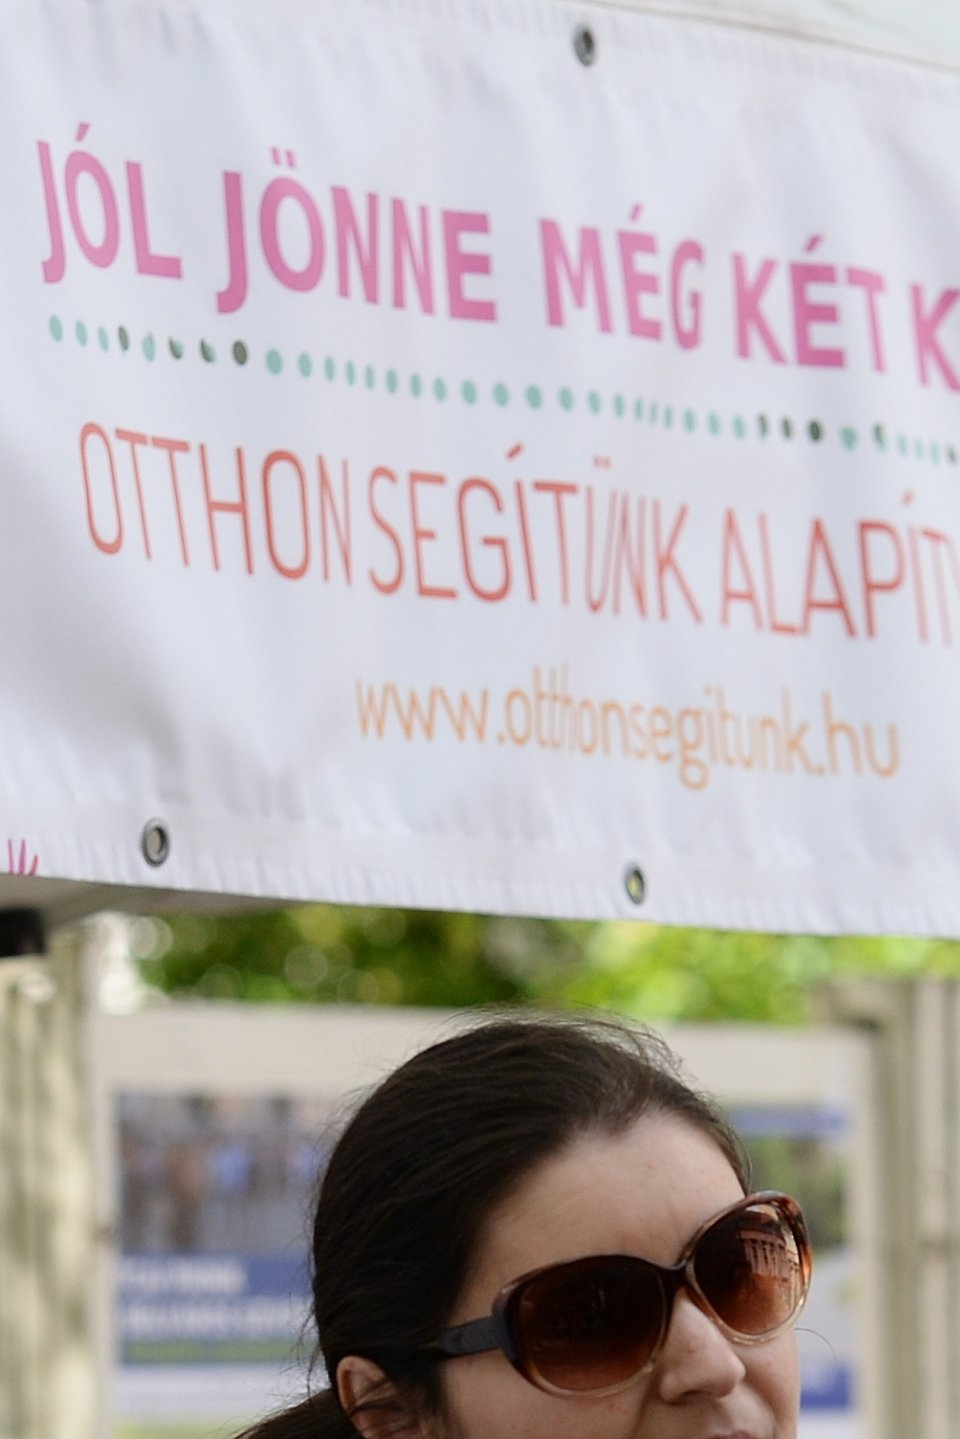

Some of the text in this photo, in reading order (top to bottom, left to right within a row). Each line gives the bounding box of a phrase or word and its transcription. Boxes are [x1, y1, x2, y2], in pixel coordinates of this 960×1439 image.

[36, 122, 183, 284] JÓL
[216, 146, 498, 324] JÖNNE
[538, 203, 704, 352] MÉG
[731, 234, 886, 374] KÉT
[355, 660, 900, 791] www.otthonsegitunk.hu
